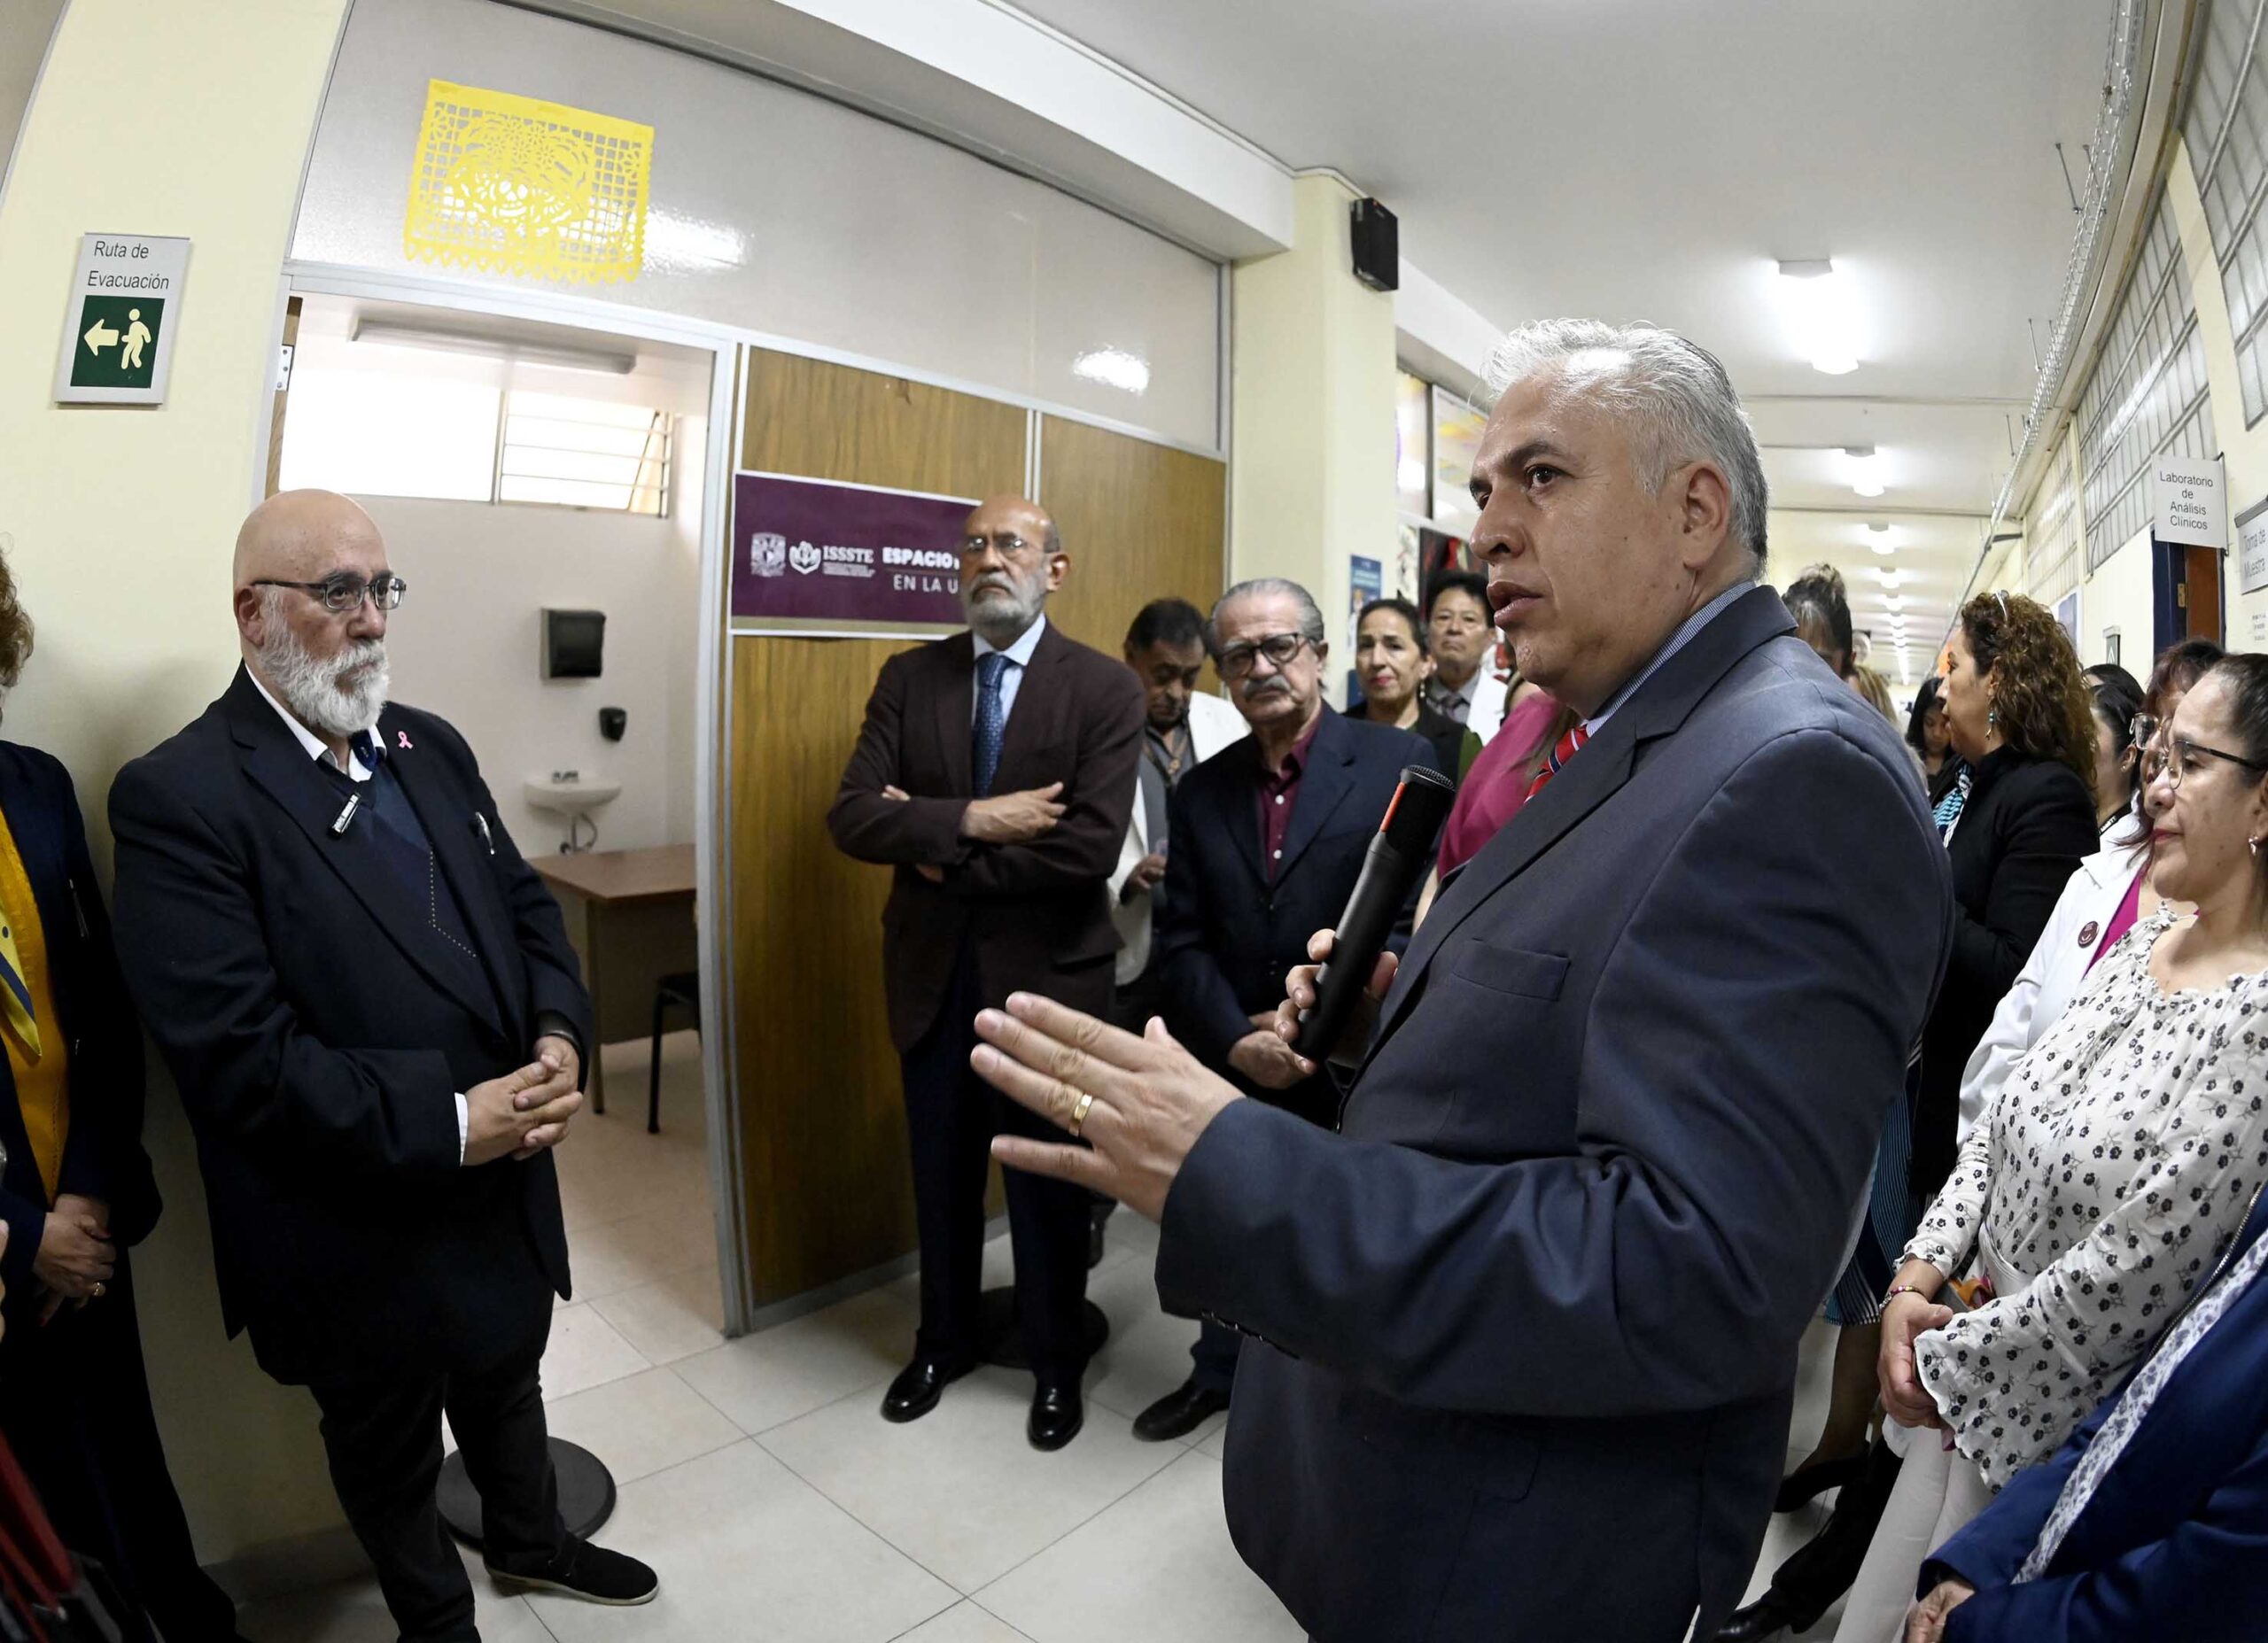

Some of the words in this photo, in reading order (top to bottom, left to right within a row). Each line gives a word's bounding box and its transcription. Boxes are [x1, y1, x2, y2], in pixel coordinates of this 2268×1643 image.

[94, 241, 127, 258] Ruta
[131, 244, 149, 259] de
[88, 270, 169, 290] Evacuación
[2160, 470, 2213, 487] Laboratorio
[2181, 488, 2194, 499] de
[2171, 501, 2207, 515] Análisis
[823, 546, 874, 563] ISSSTE
[893, 574, 916, 591] EN
[922, 577, 942, 593] LA
